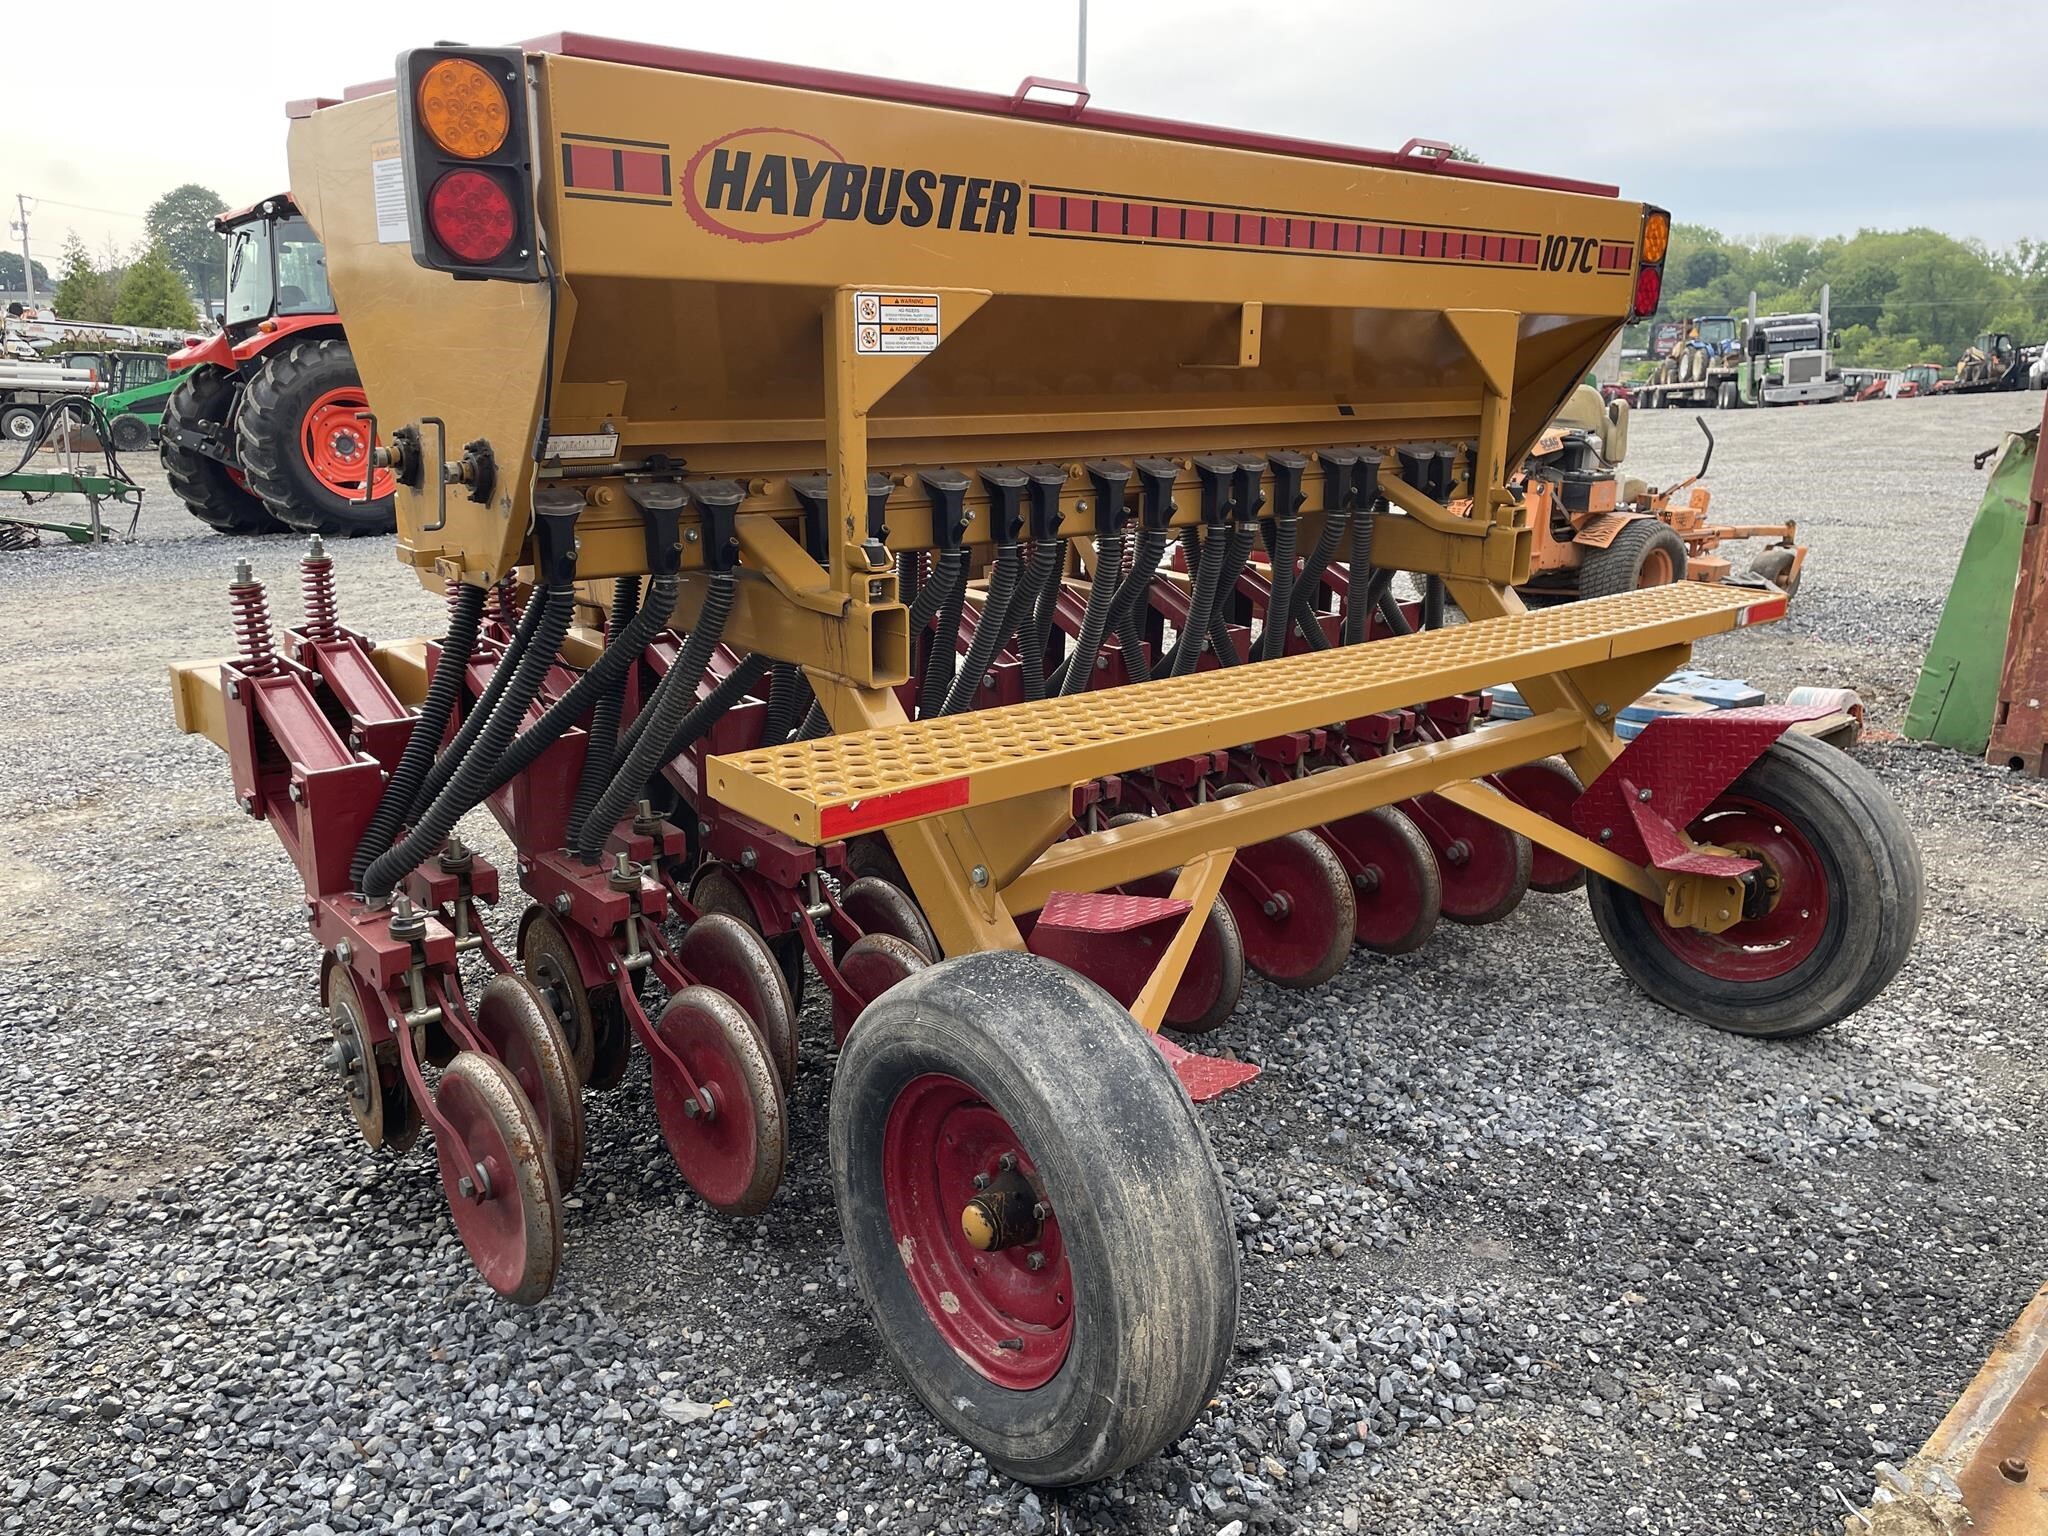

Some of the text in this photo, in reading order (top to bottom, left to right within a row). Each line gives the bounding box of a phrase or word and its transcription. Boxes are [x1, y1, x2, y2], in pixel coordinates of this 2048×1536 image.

[706, 149, 1021, 235] HAYBUSTER
[1541, 235, 1599, 273] 107C
[1540, 437, 1559, 448] SCAG
